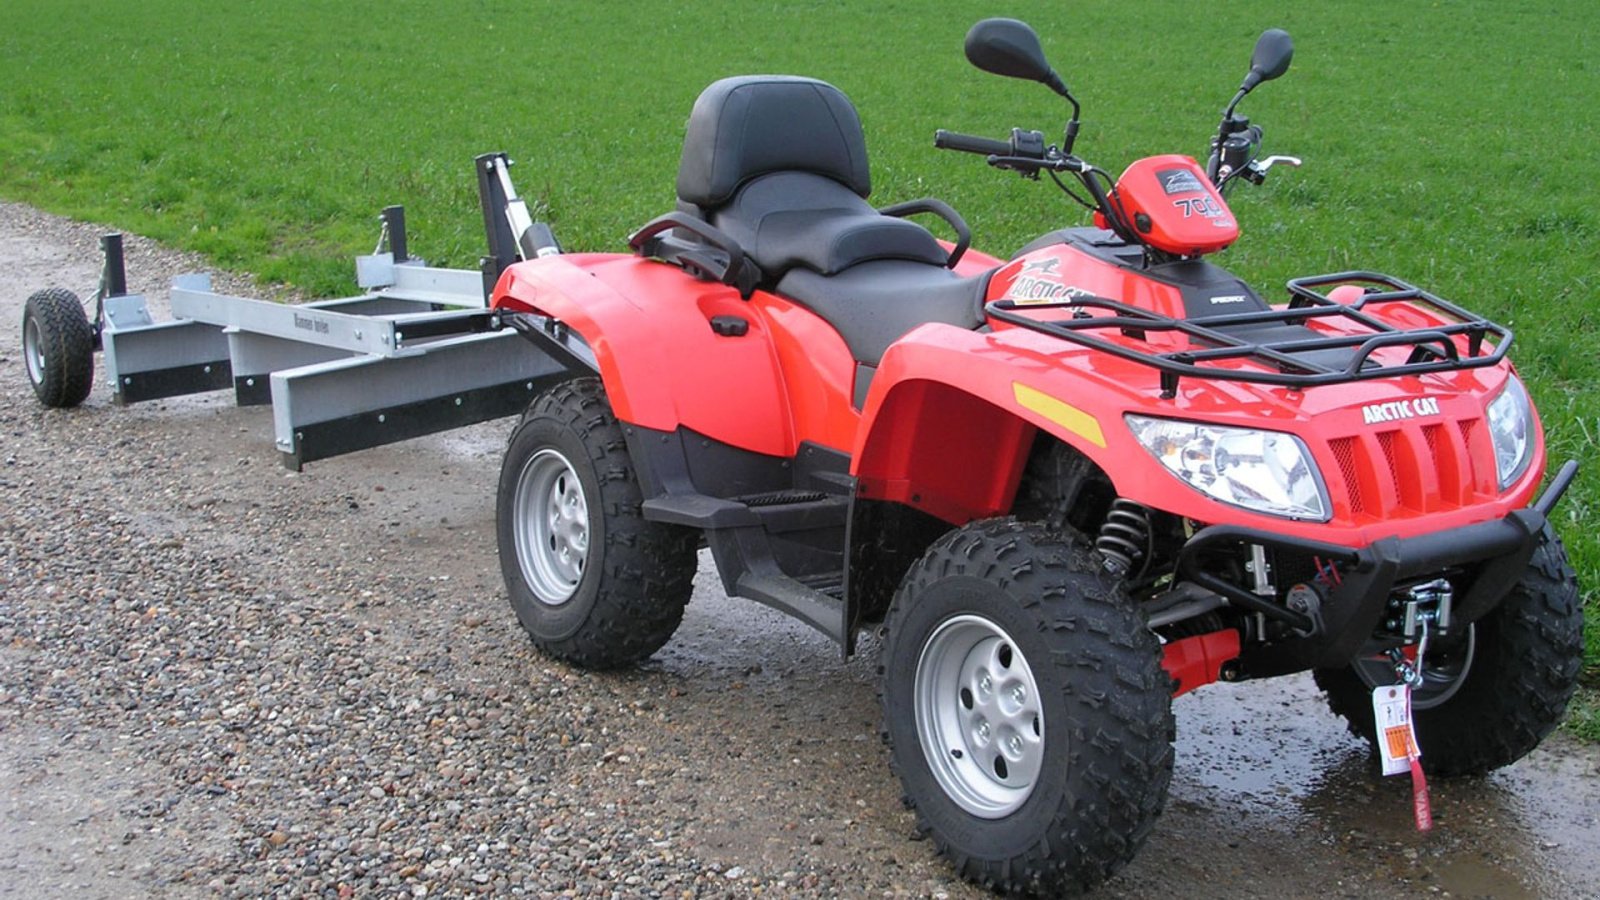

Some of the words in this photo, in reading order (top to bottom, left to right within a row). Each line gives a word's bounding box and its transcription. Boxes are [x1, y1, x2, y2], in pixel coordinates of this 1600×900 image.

[1010, 275, 1064, 299] ARCTIC
[1362, 400, 1414, 424] ARCTIC
[1412, 397, 1440, 416] CAT
[1416, 790, 1431, 831] WARN
